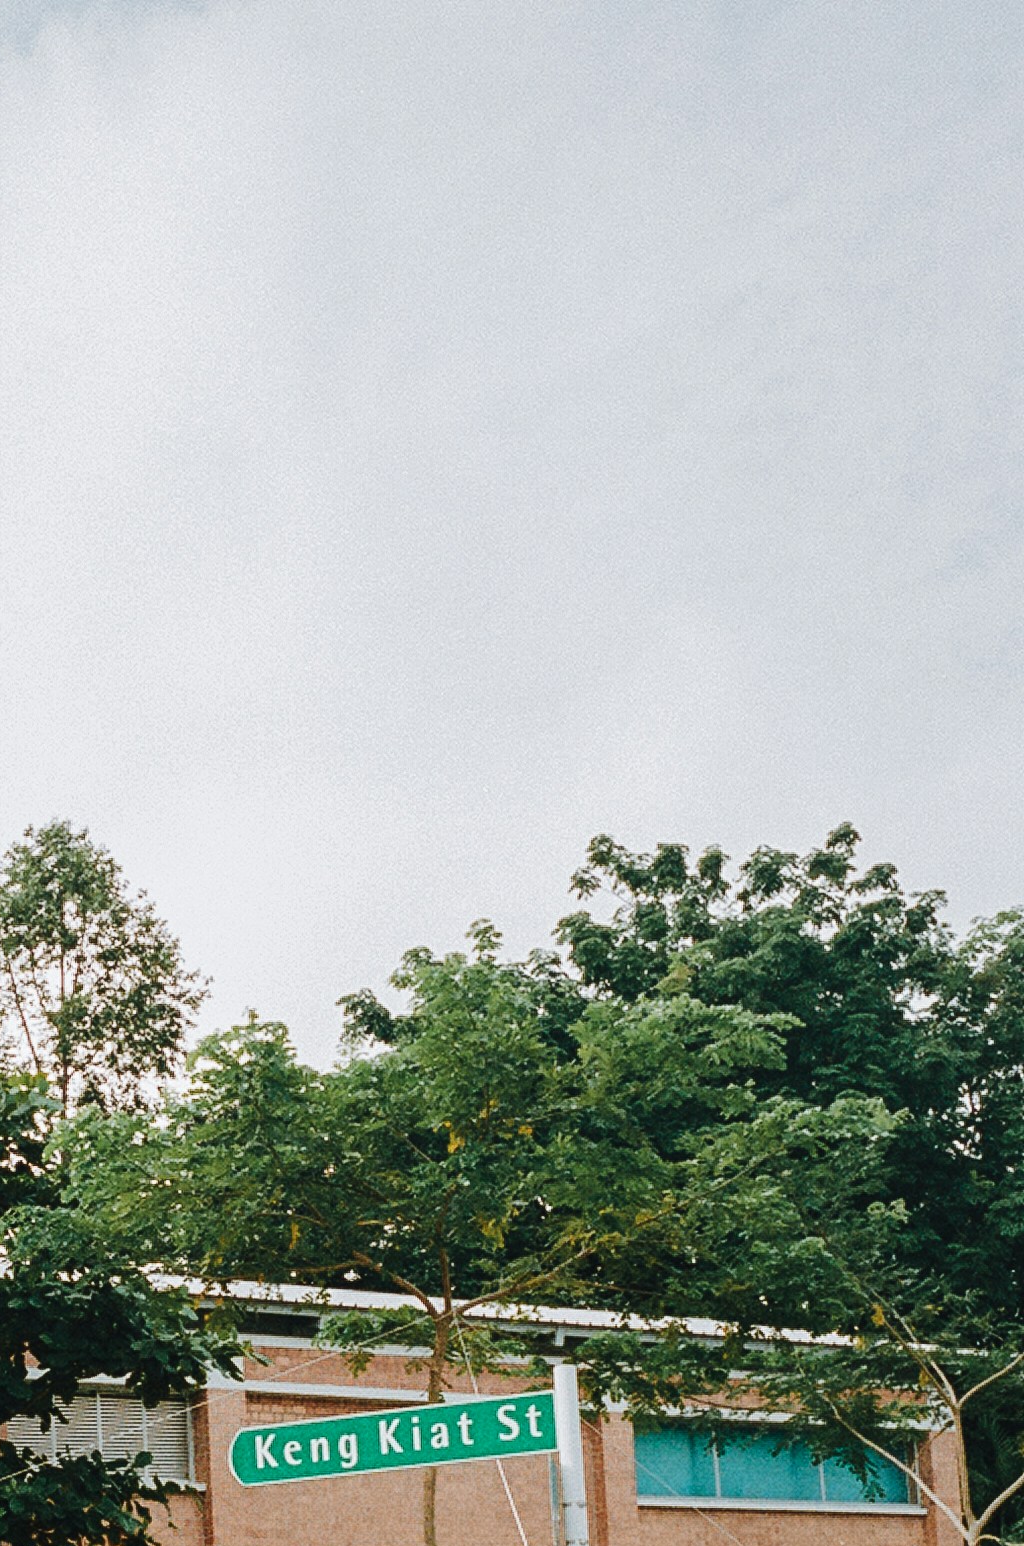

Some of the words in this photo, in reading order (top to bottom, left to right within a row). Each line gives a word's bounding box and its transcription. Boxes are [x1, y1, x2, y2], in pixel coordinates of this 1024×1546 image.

[254, 1433, 359, 1469] Keng
[378, 1412, 475, 1455] Kiat
[496, 1403, 543, 1441] St
